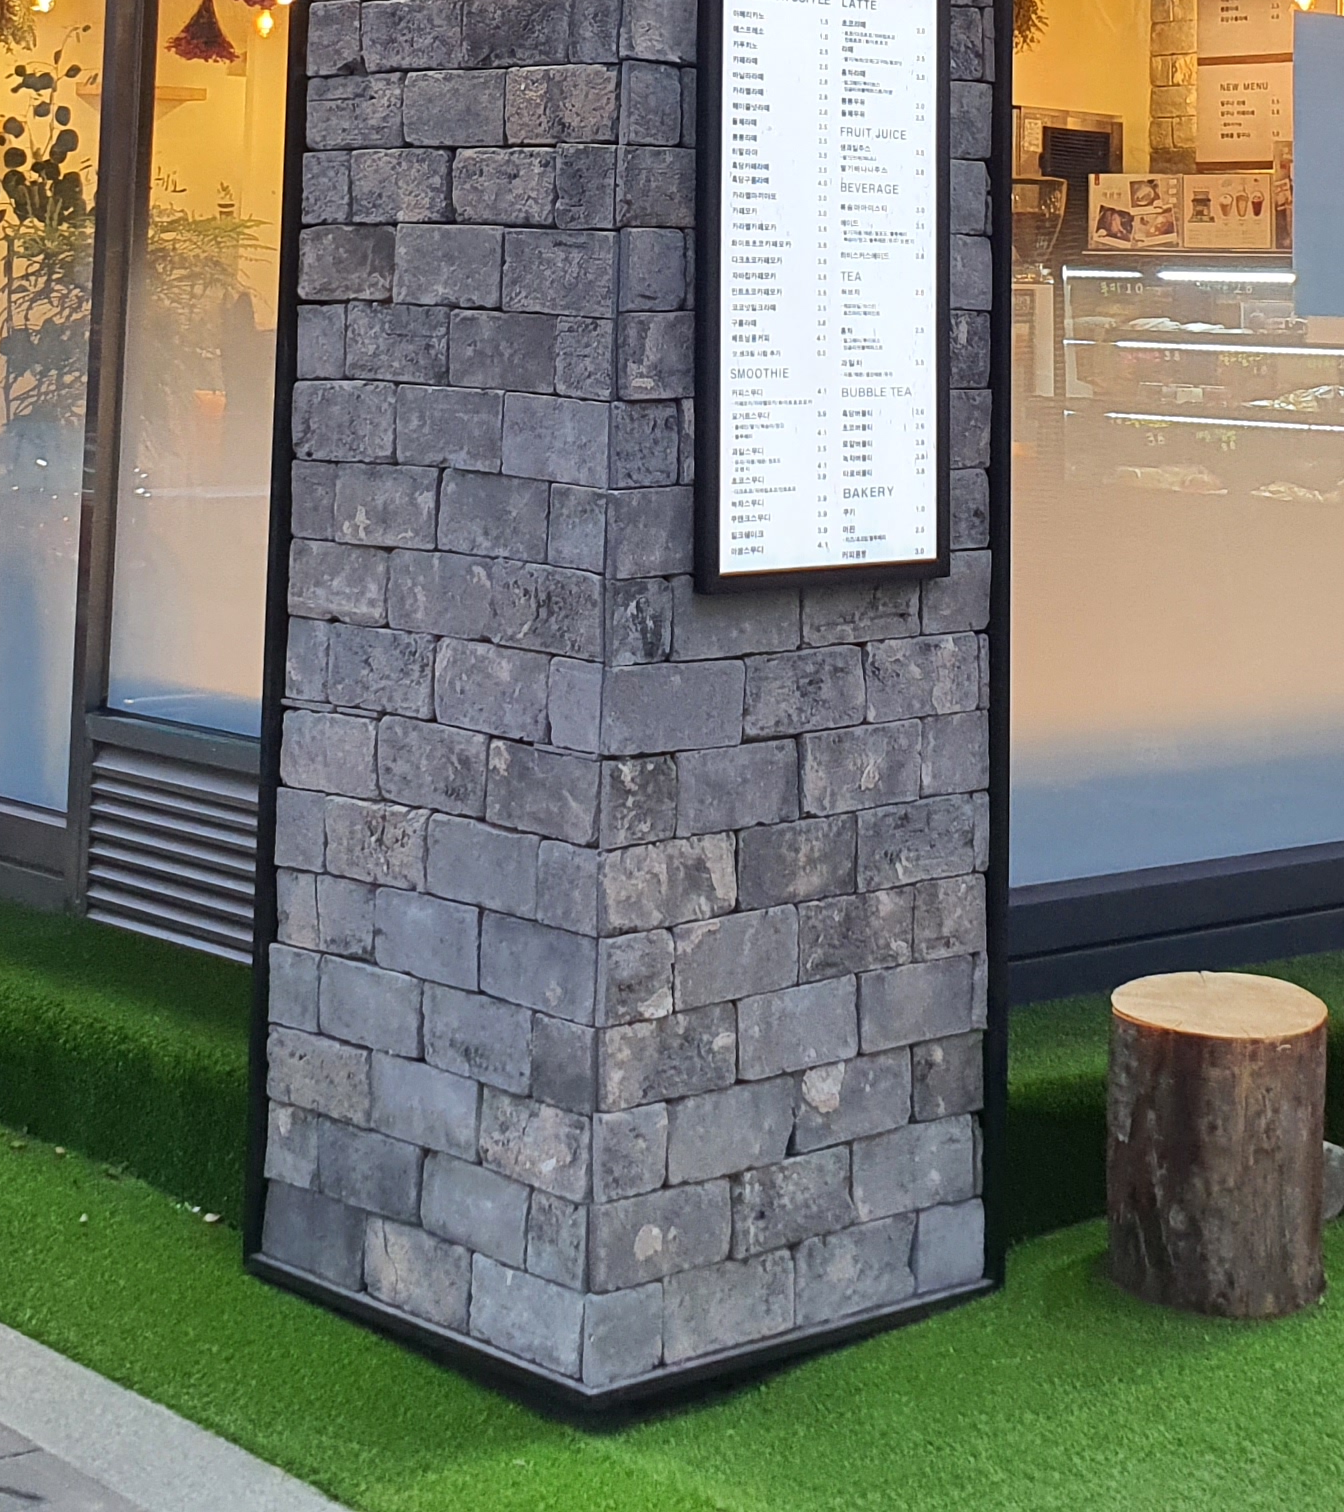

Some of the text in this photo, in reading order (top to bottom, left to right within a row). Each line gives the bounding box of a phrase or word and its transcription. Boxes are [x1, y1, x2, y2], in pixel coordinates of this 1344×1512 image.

[733, 10, 765, 19] 아메리카노
[733, 25, 765, 35] 에스프레소
[733, 40, 758, 49] 카푸치노
[733, 56, 758, 65] 카페라떼
[1219, 82, 1269, 91] NEW MENU
[840, 126, 907, 140] FRUIT JUICE
[840, 144, 871, 152] 생과일주스
[840, 165, 888, 174] 딸기바나나주스
[840, 182, 899, 194] BEVERAGE
[732, 207, 758, 215] 카페모카
[840, 271, 862, 282] TEA
[730, 368, 789, 379] SMOOTHIE
[732, 389, 763, 397] 커피스무디
[841, 387, 912, 398] BUBBLE TEA
[732, 411, 770, 420] 요거트스무디
[731, 476, 764, 484] 초코스무디
[843, 486, 894, 499] BAKERY
[731, 499, 764, 508] 녹차스무디
[843, 508, 856, 517] 쿠키
